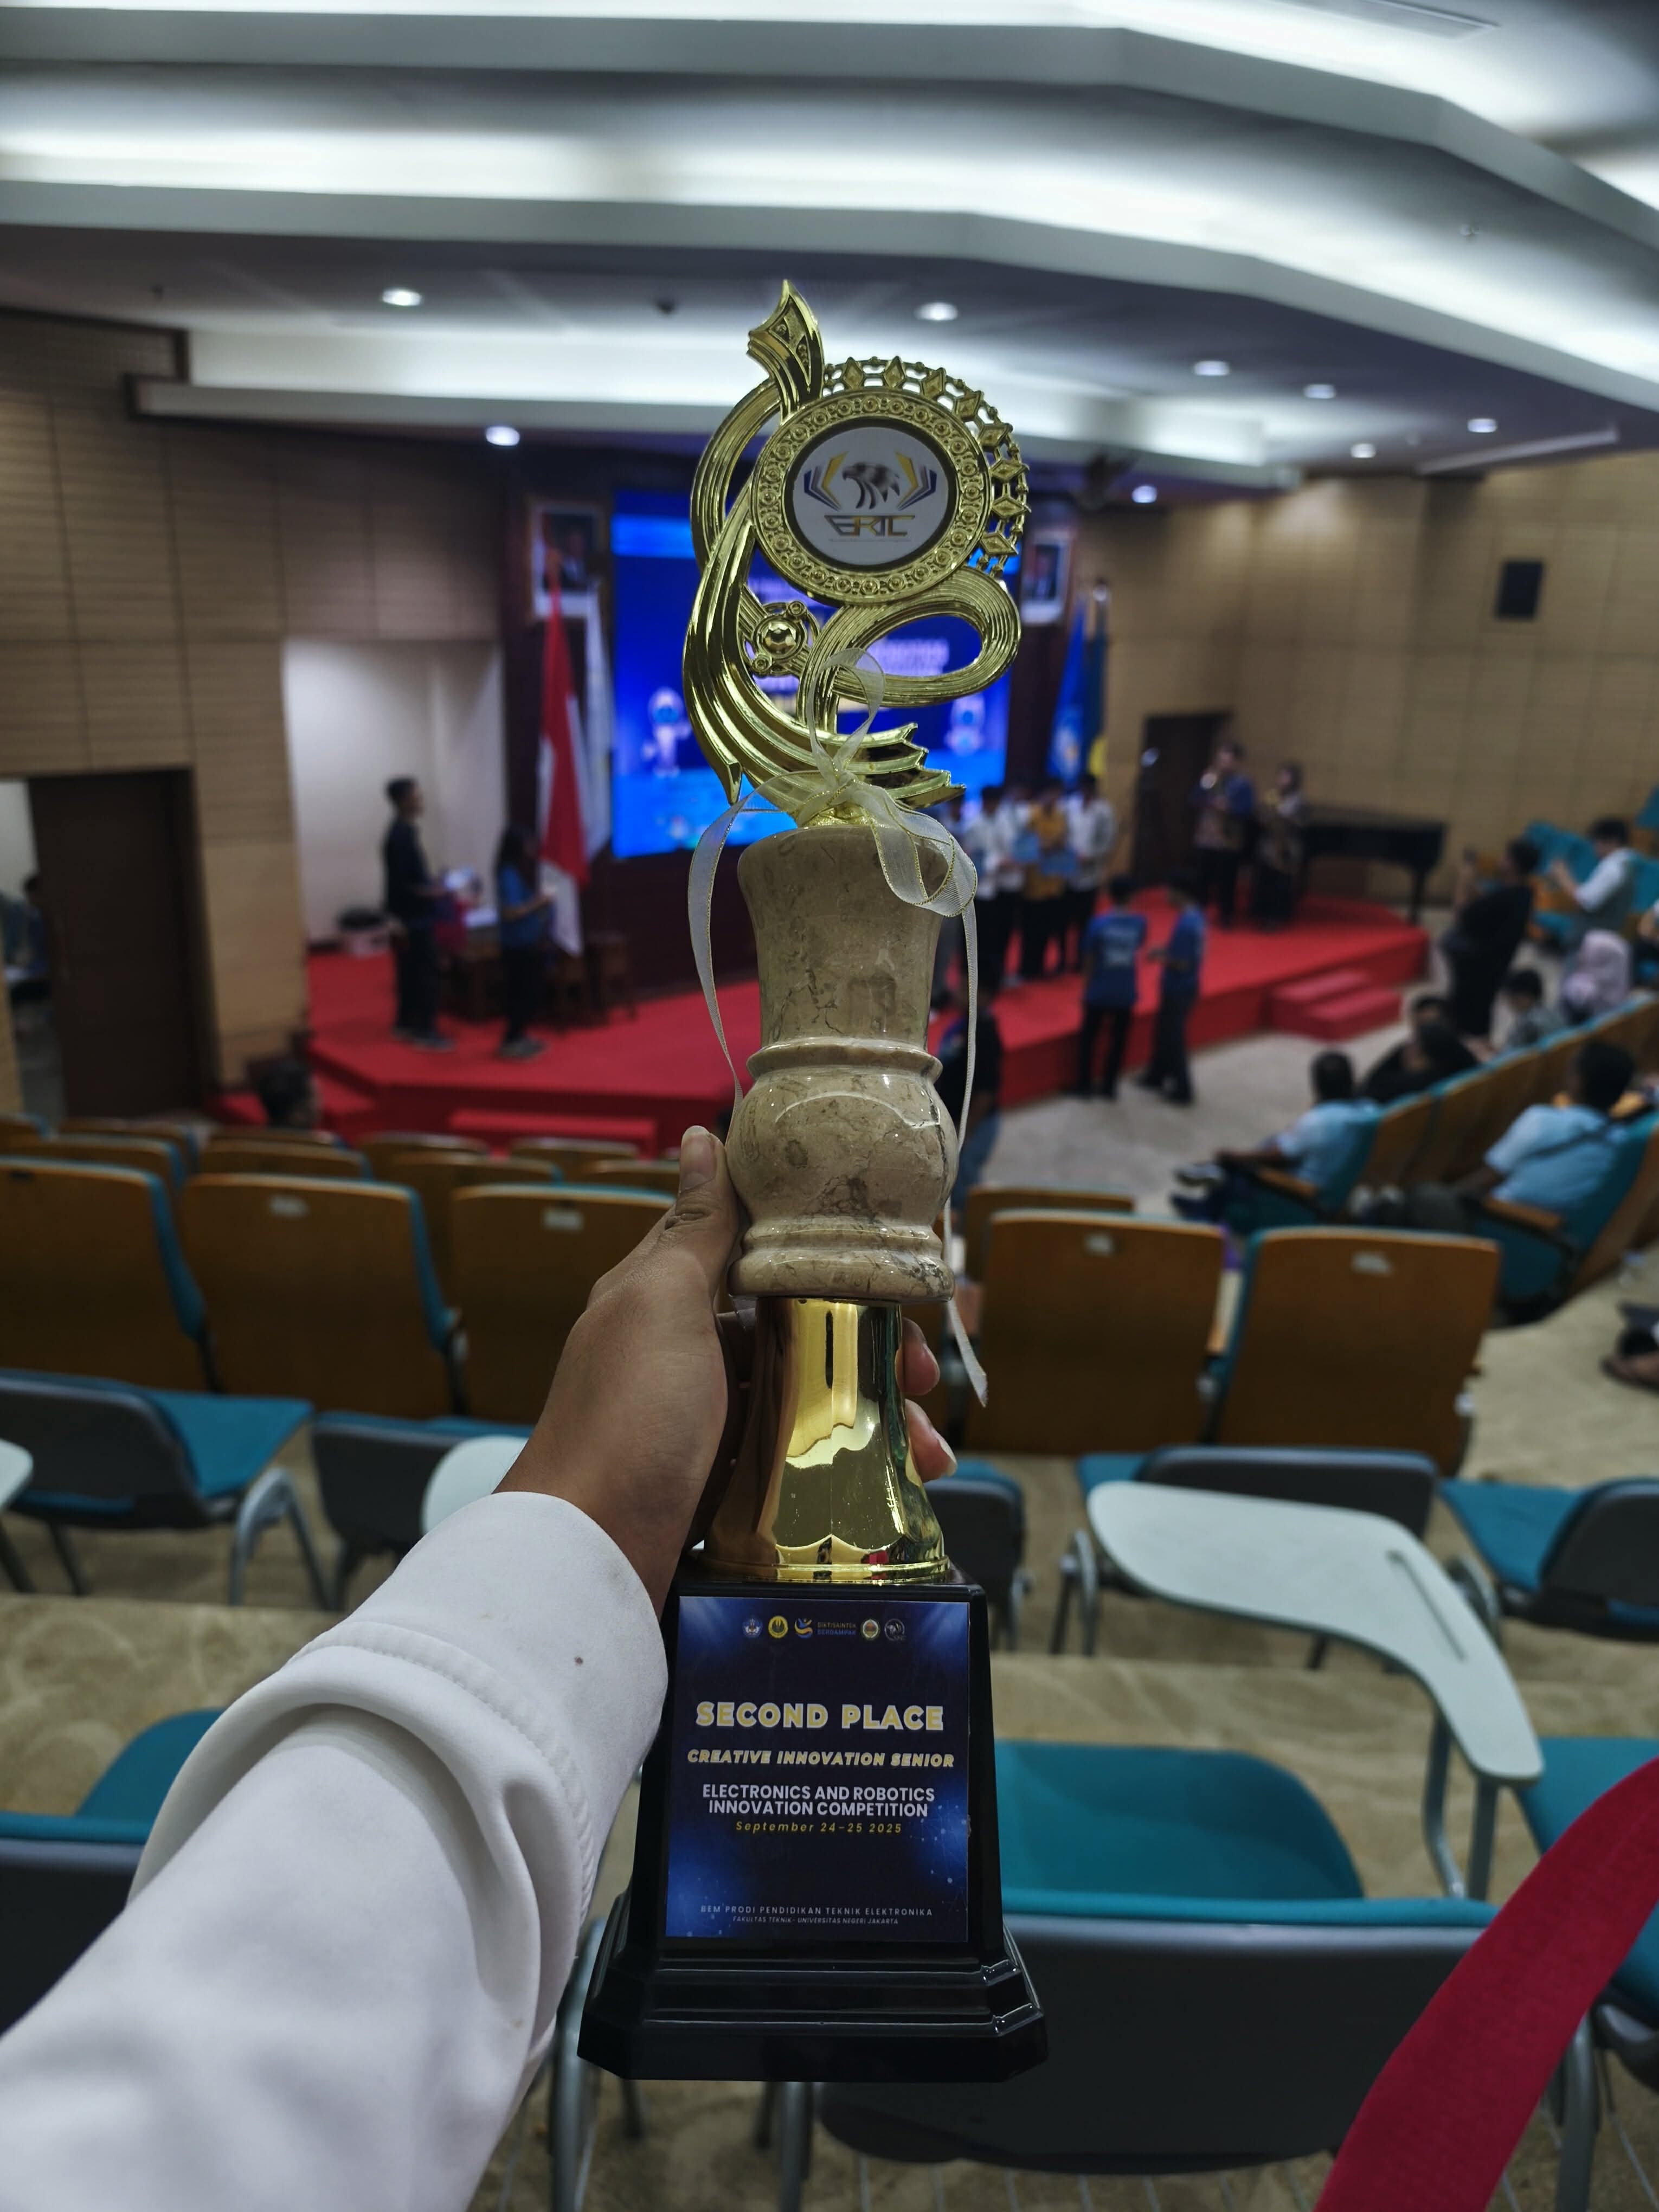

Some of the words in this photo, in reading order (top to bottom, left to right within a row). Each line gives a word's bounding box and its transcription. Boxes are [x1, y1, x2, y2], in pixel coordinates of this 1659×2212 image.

[696, 1701, 828, 1728] SECOND
[841, 1704, 943, 1731] PLACE
[687, 1749, 771, 1764] CREATIVE
[776, 1751, 885, 1766] INNOVATION
[890, 1753, 954, 1767] SENIOR
[703, 1784, 811, 1799] ELECTRONICS
[814, 1786, 850, 1801] AND
[853, 1787, 935, 1802] ROBOTICS
[709, 1801, 813, 1815] INNOVATION
[816, 1802, 928, 1817] COMPETITION
[736, 1821, 814, 1834] September
[820, 1823, 863, 1832] 24-25
[869, 1824, 902, 1833] 2025
[760, 1906, 821, 1914] PENDIDIKAN
[865, 1908, 933, 1916] ELEKTRONIKA
